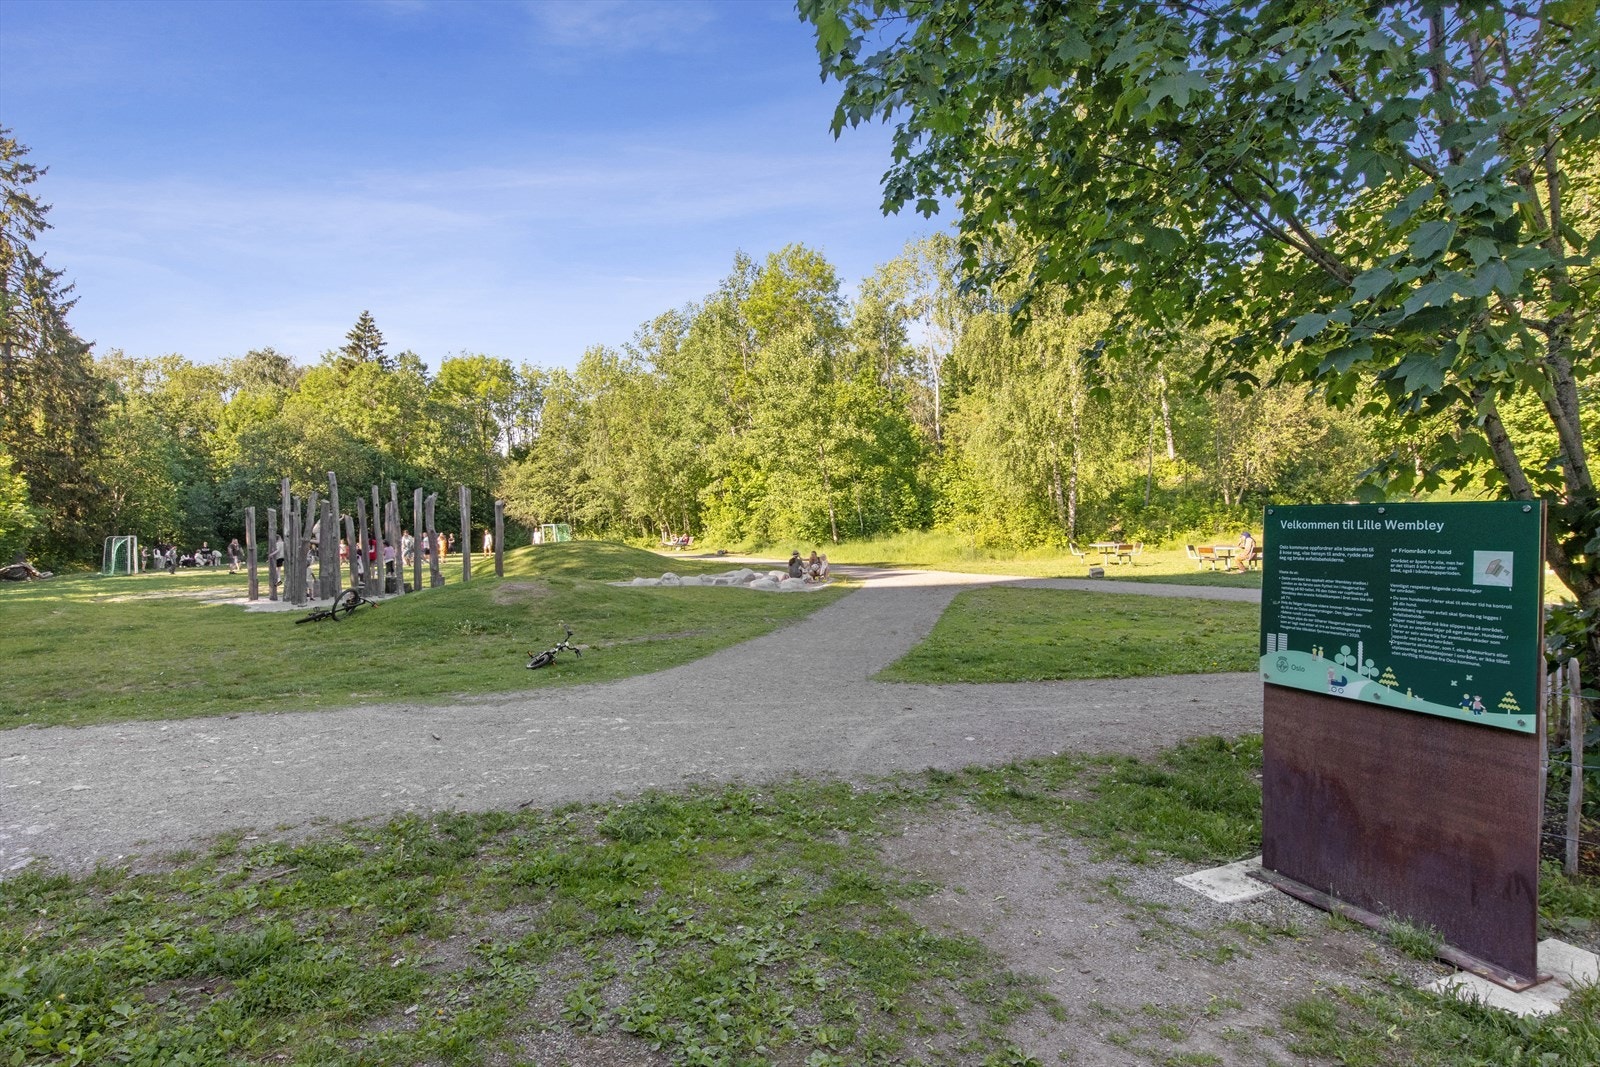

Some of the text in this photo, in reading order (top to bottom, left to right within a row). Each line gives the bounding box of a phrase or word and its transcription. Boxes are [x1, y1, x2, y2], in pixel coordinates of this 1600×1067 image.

[1280, 520, 1444, 532] Velkommen til Lille Wembley
[1290, 664, 1306, 672] Oslo
